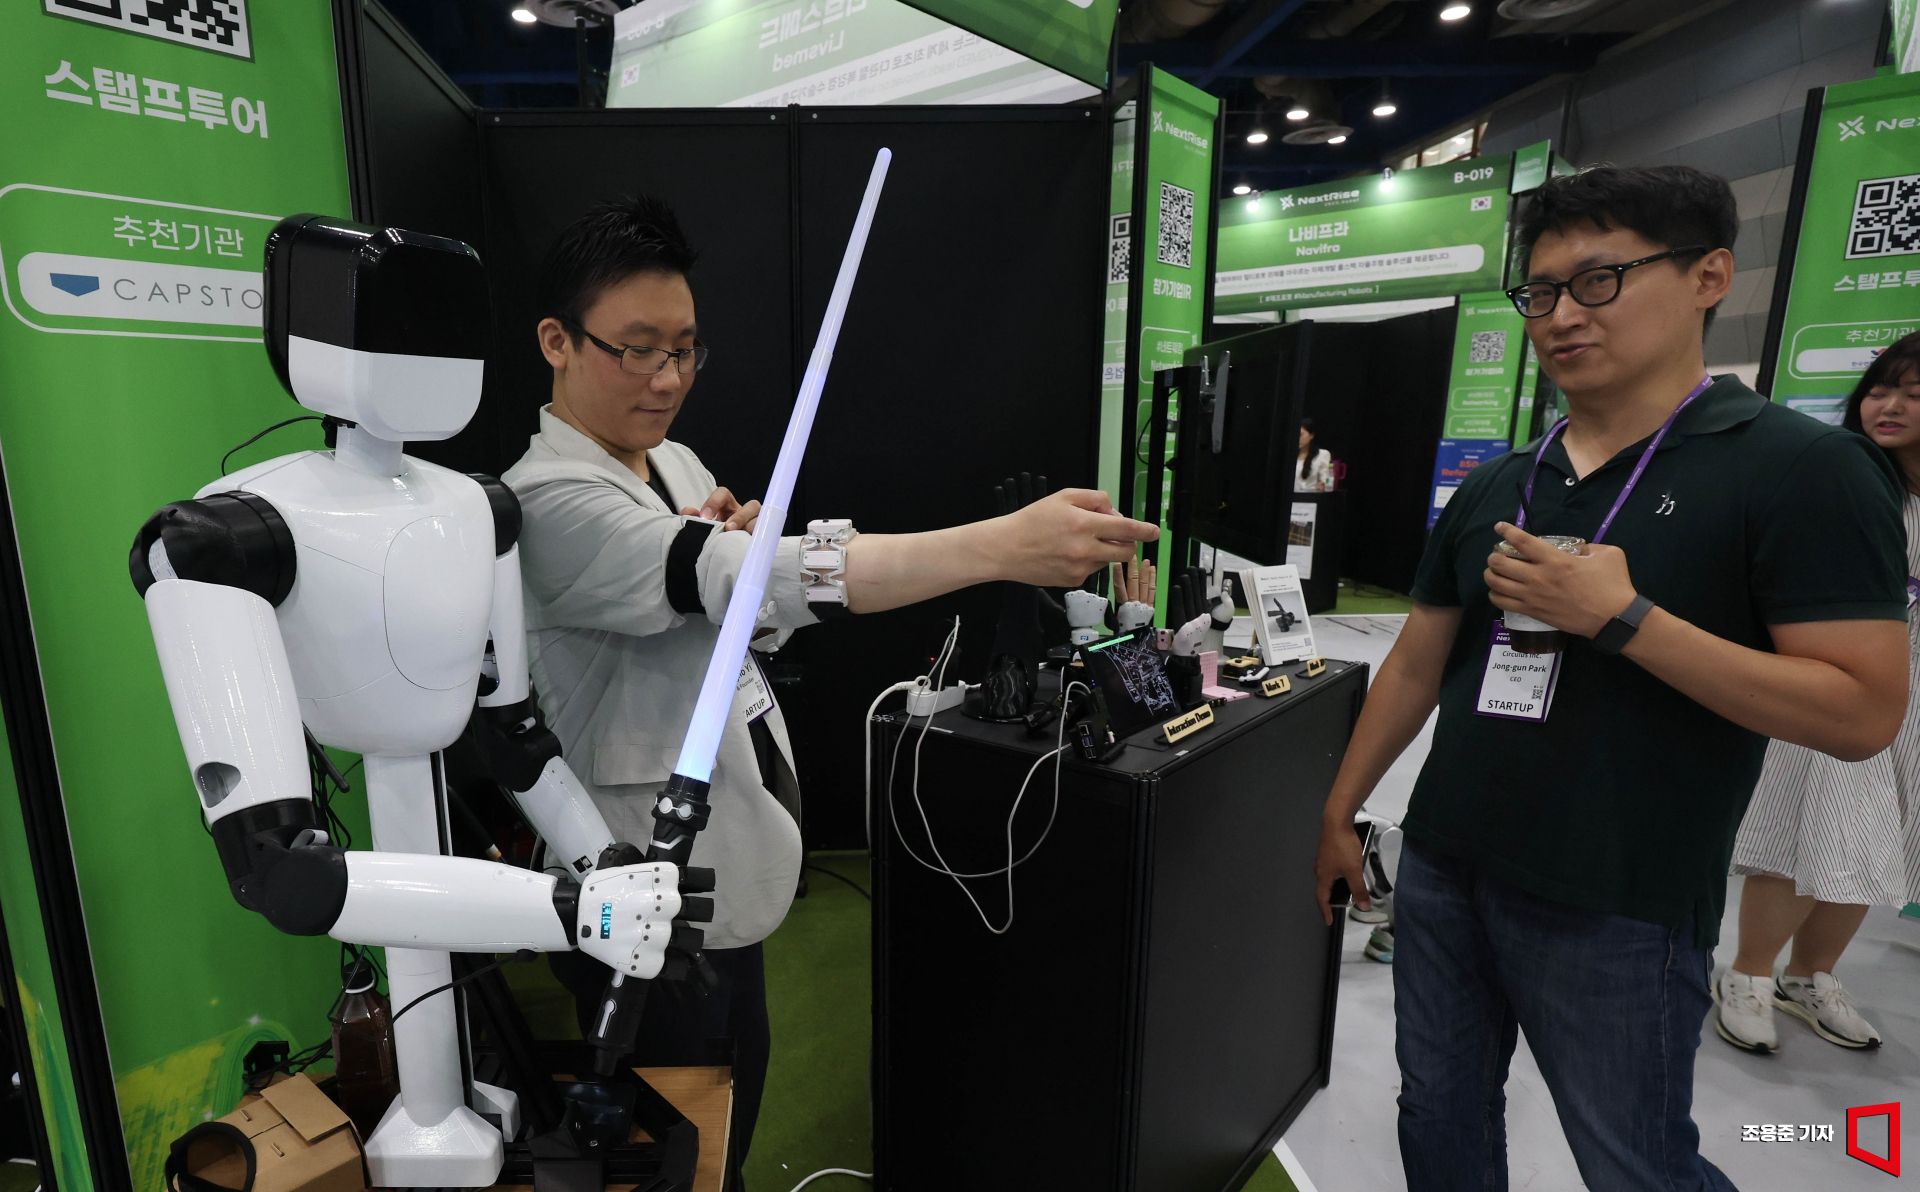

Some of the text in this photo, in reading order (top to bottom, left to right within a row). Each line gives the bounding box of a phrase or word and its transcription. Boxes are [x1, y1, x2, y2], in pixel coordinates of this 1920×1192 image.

[44, 60, 269, 139] 스탬프투어
[1876, 118, 1920, 132] Ne
[1165, 122, 1209, 149] NextRise
[1454, 166, 1494, 184] B-019
[1297, 189, 1360, 205] NextRise
[113, 215, 244, 258] 추천기관
[1289, 221, 1349, 243] 나비프라
[1296, 243, 1341, 257] Navifra
[113, 278, 264, 310] CAPSTO
[1153, 277, 1192, 300] 참가기업IR
[1492, 662, 1547, 673] Jong-gun Park
[745, 698, 766, 718] ARTUP
[1487, 699, 1534, 713] STARTUP
